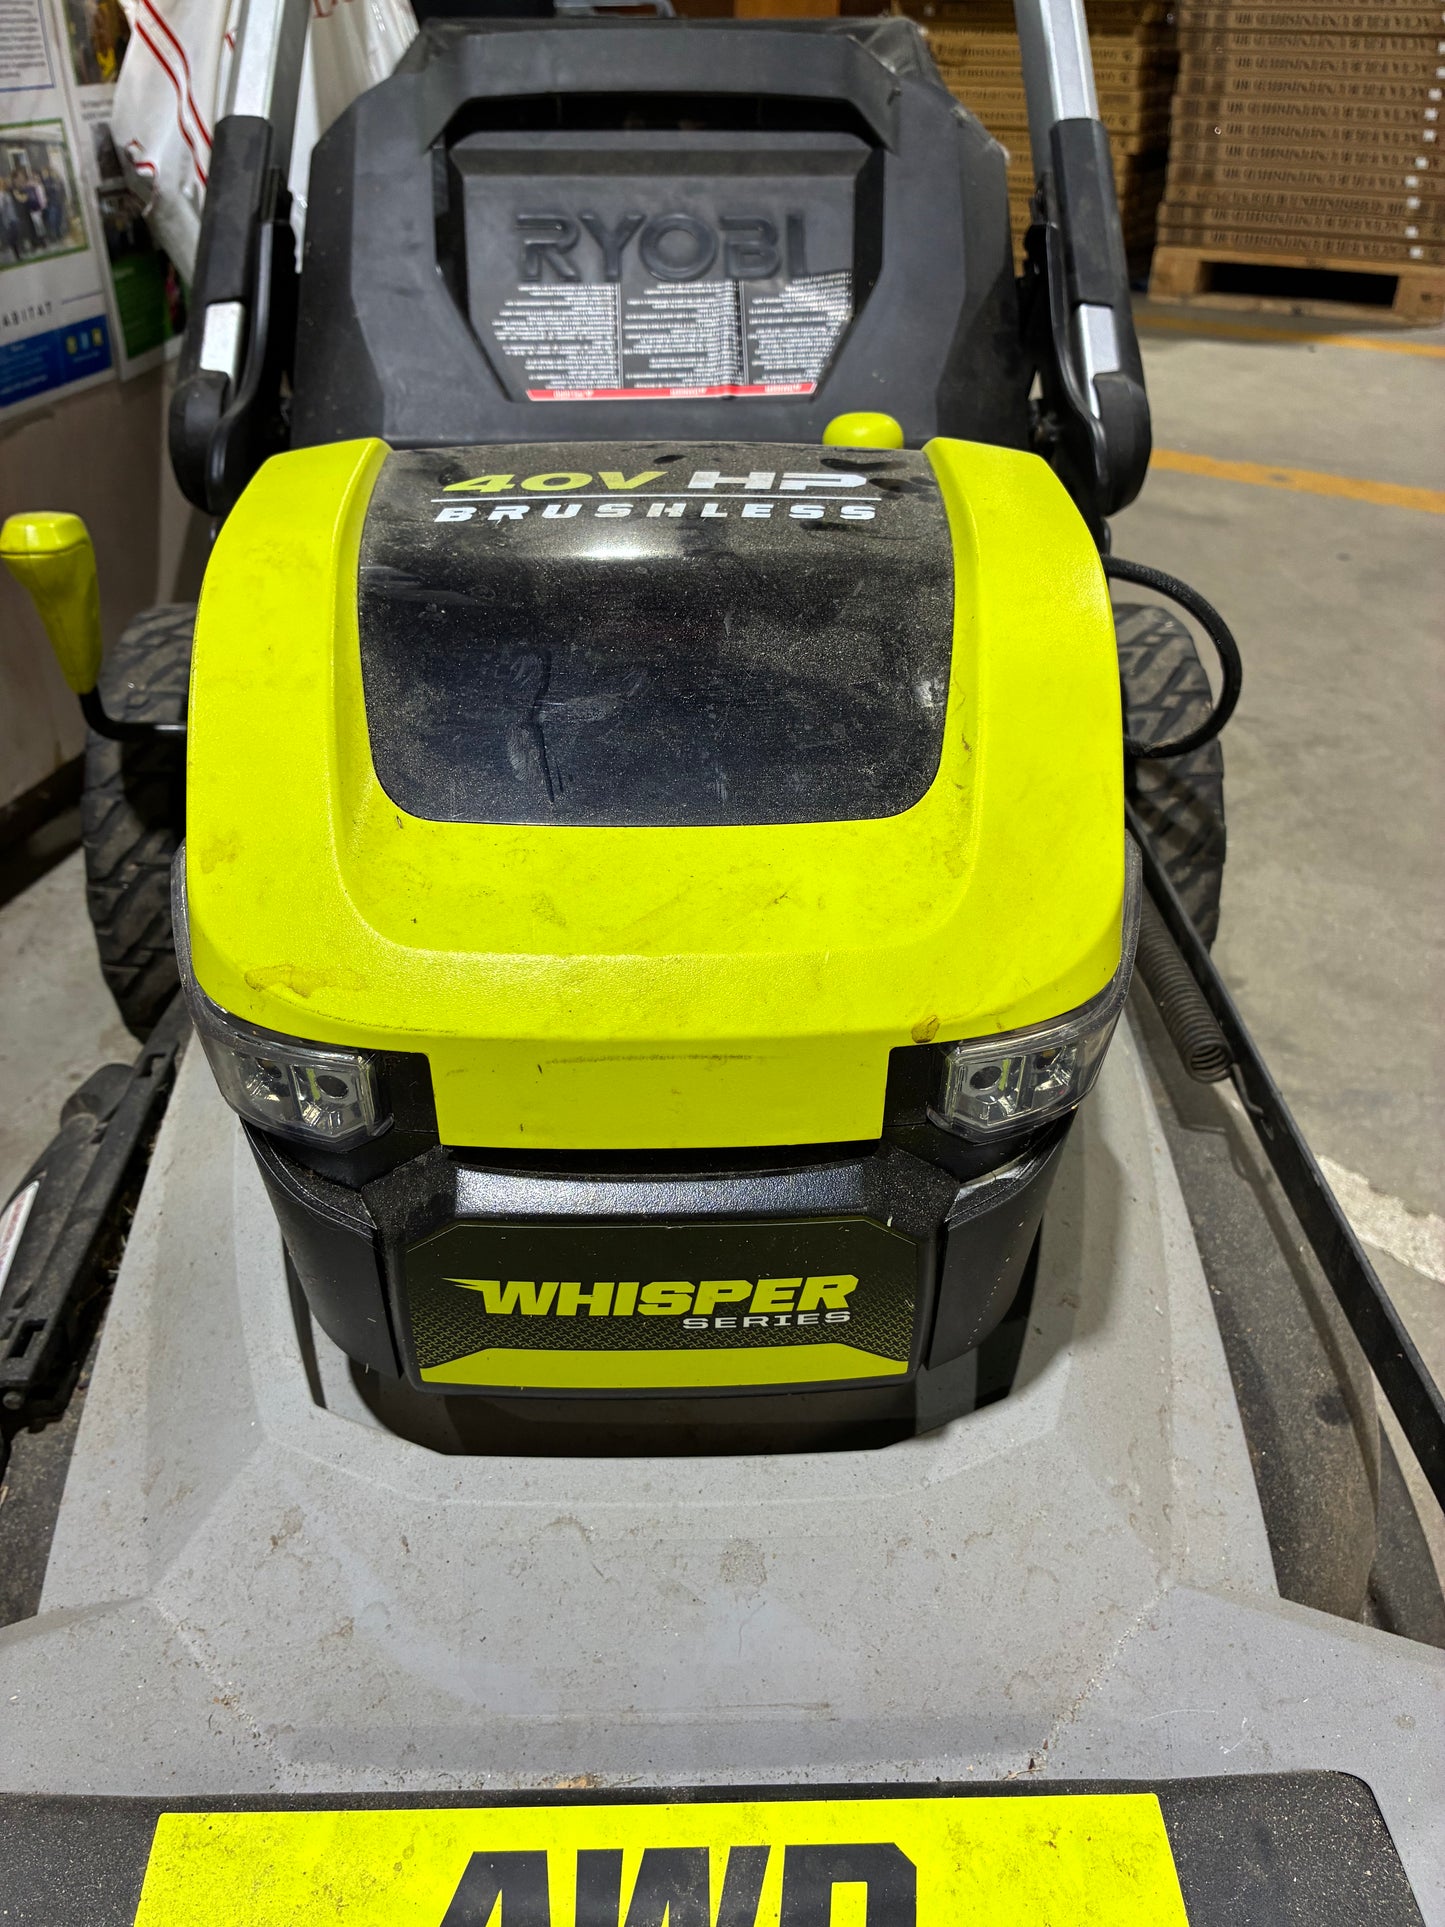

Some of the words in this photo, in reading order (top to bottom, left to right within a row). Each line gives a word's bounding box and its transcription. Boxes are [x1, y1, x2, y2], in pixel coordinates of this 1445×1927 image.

[515, 213, 807, 282] RYOBI
[0, 300, 53, 328] ABITAT
[442, 470, 669, 493] 40V
[687, 471, 868, 491] HP
[433, 502, 876, 522] BRUSHLESS
[442, 1274, 859, 1316] WHISPER
[682, 1310, 851, 1330] SERIES
